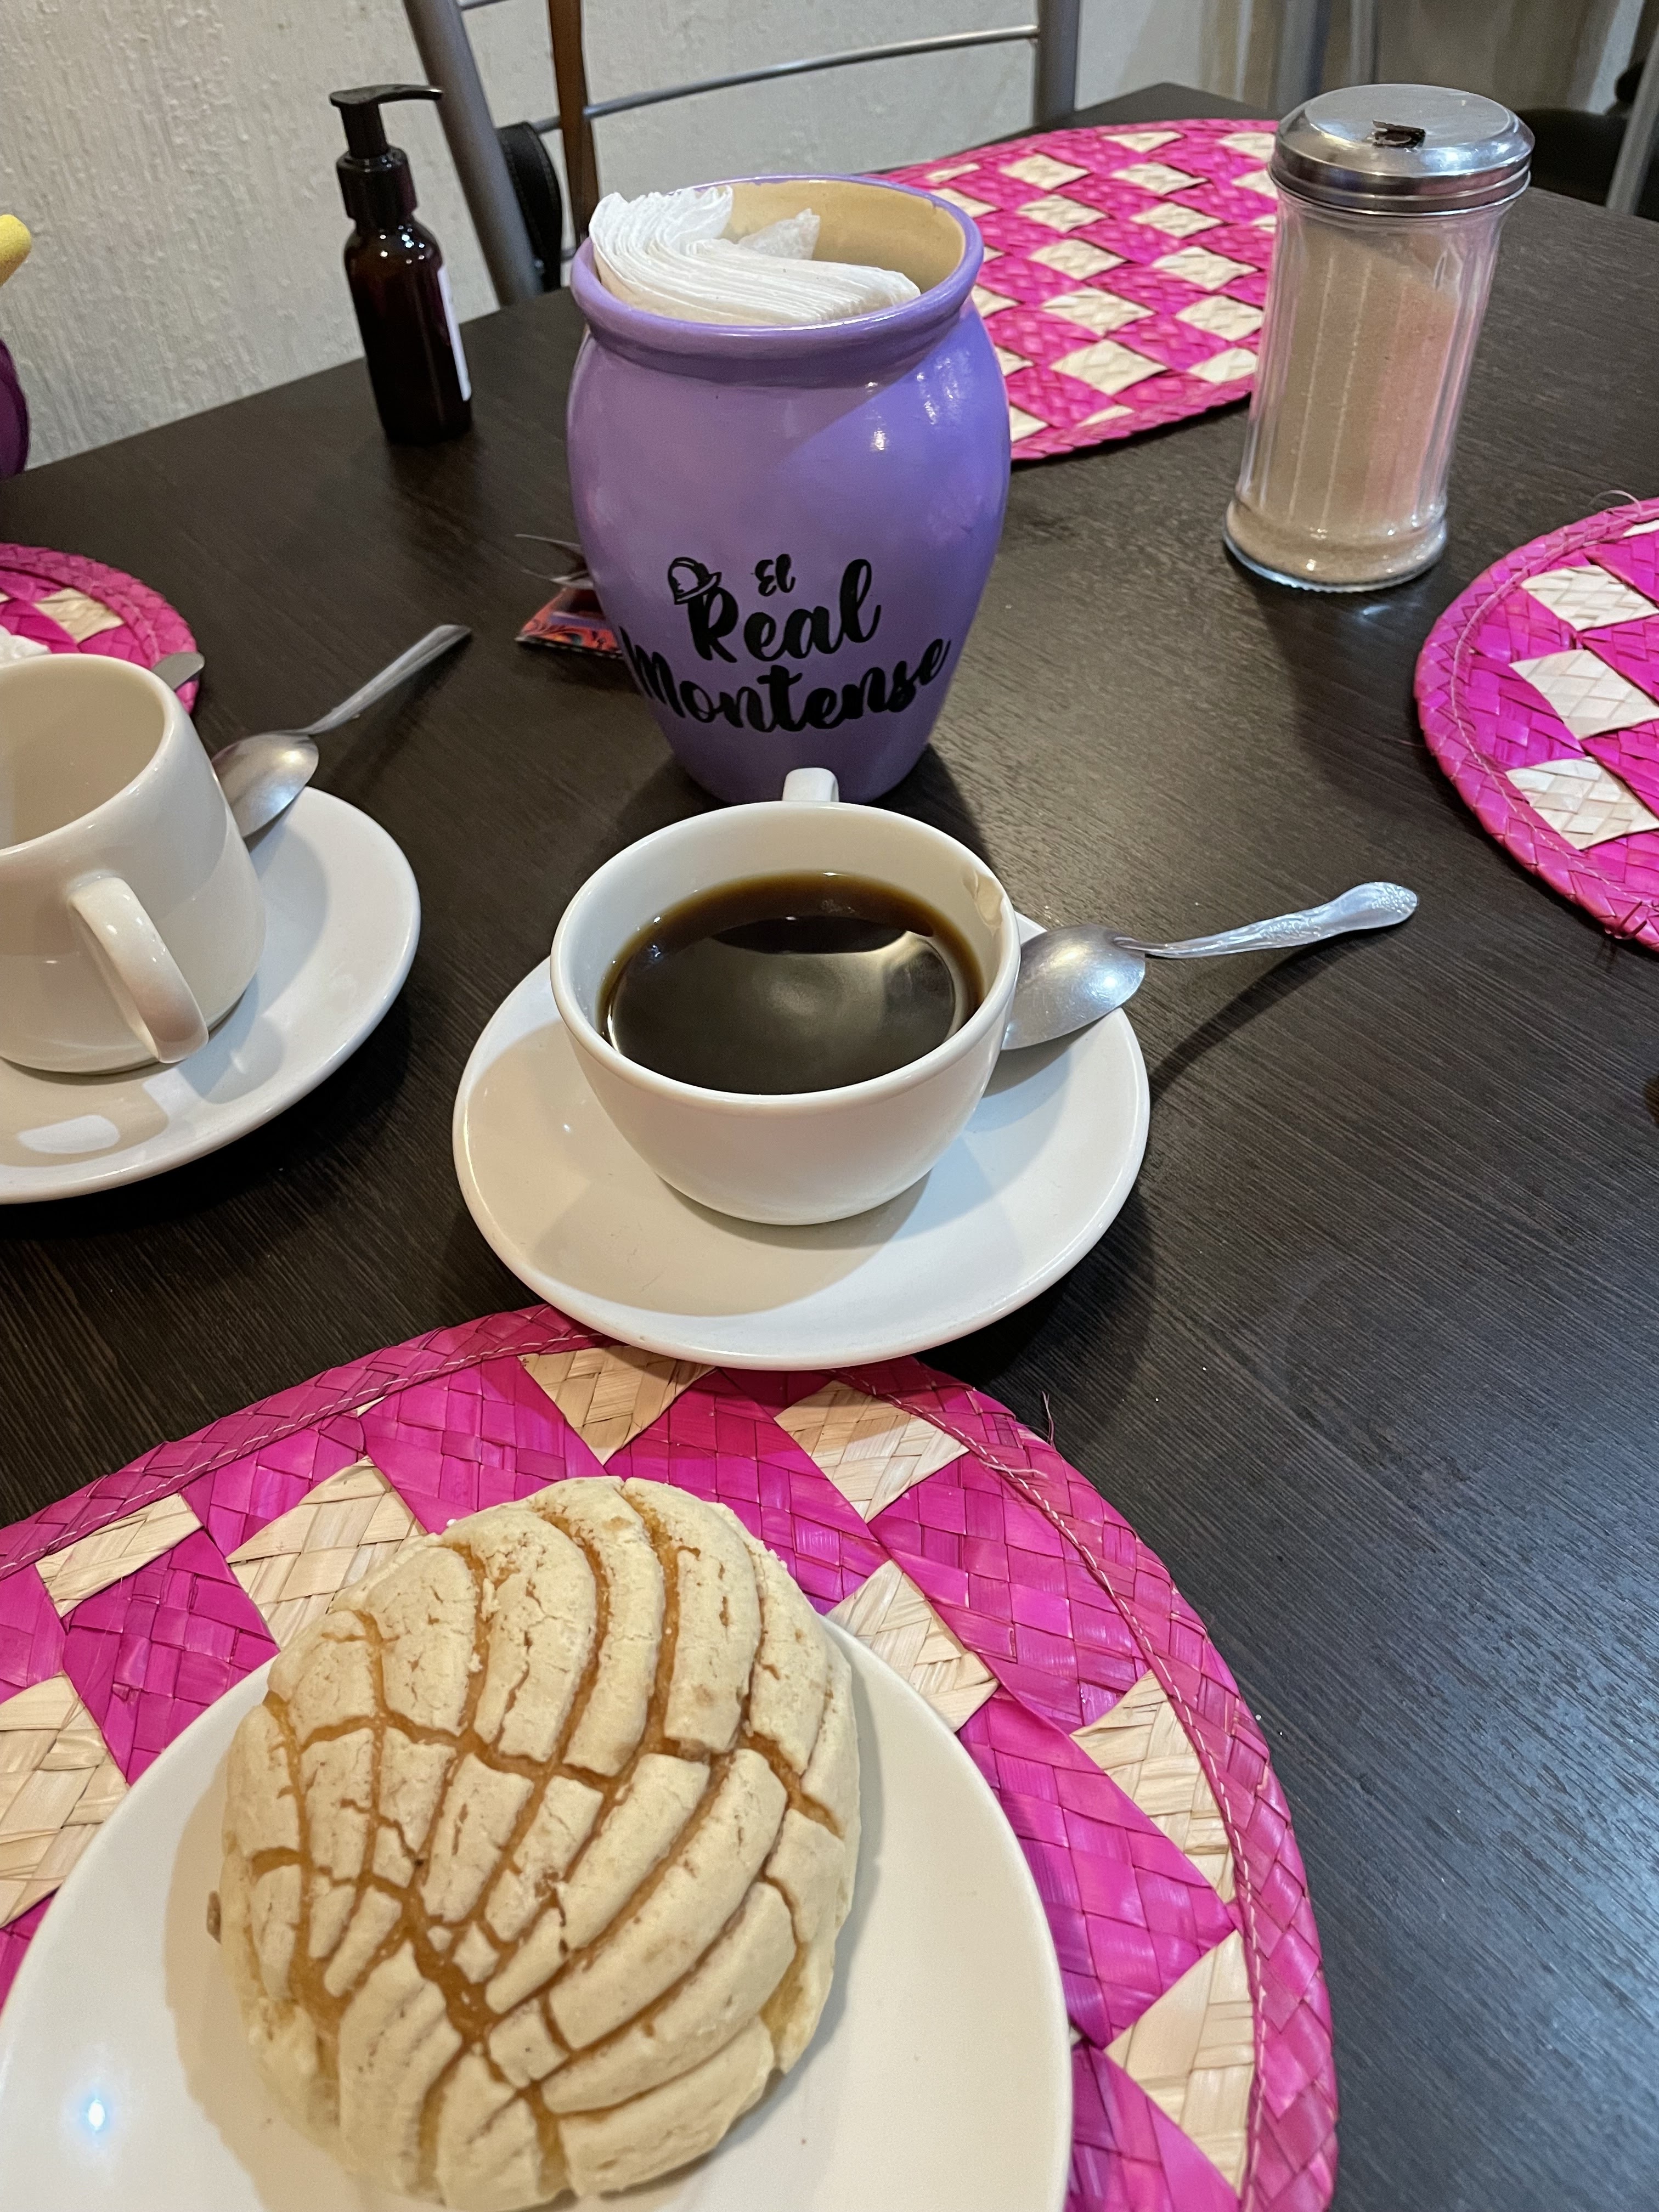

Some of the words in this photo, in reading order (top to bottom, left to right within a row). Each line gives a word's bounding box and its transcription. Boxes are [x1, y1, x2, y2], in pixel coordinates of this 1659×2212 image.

[686, 558, 881, 663] Real
[754, 554, 795, 596] El
[619, 626, 951, 732] Montense
